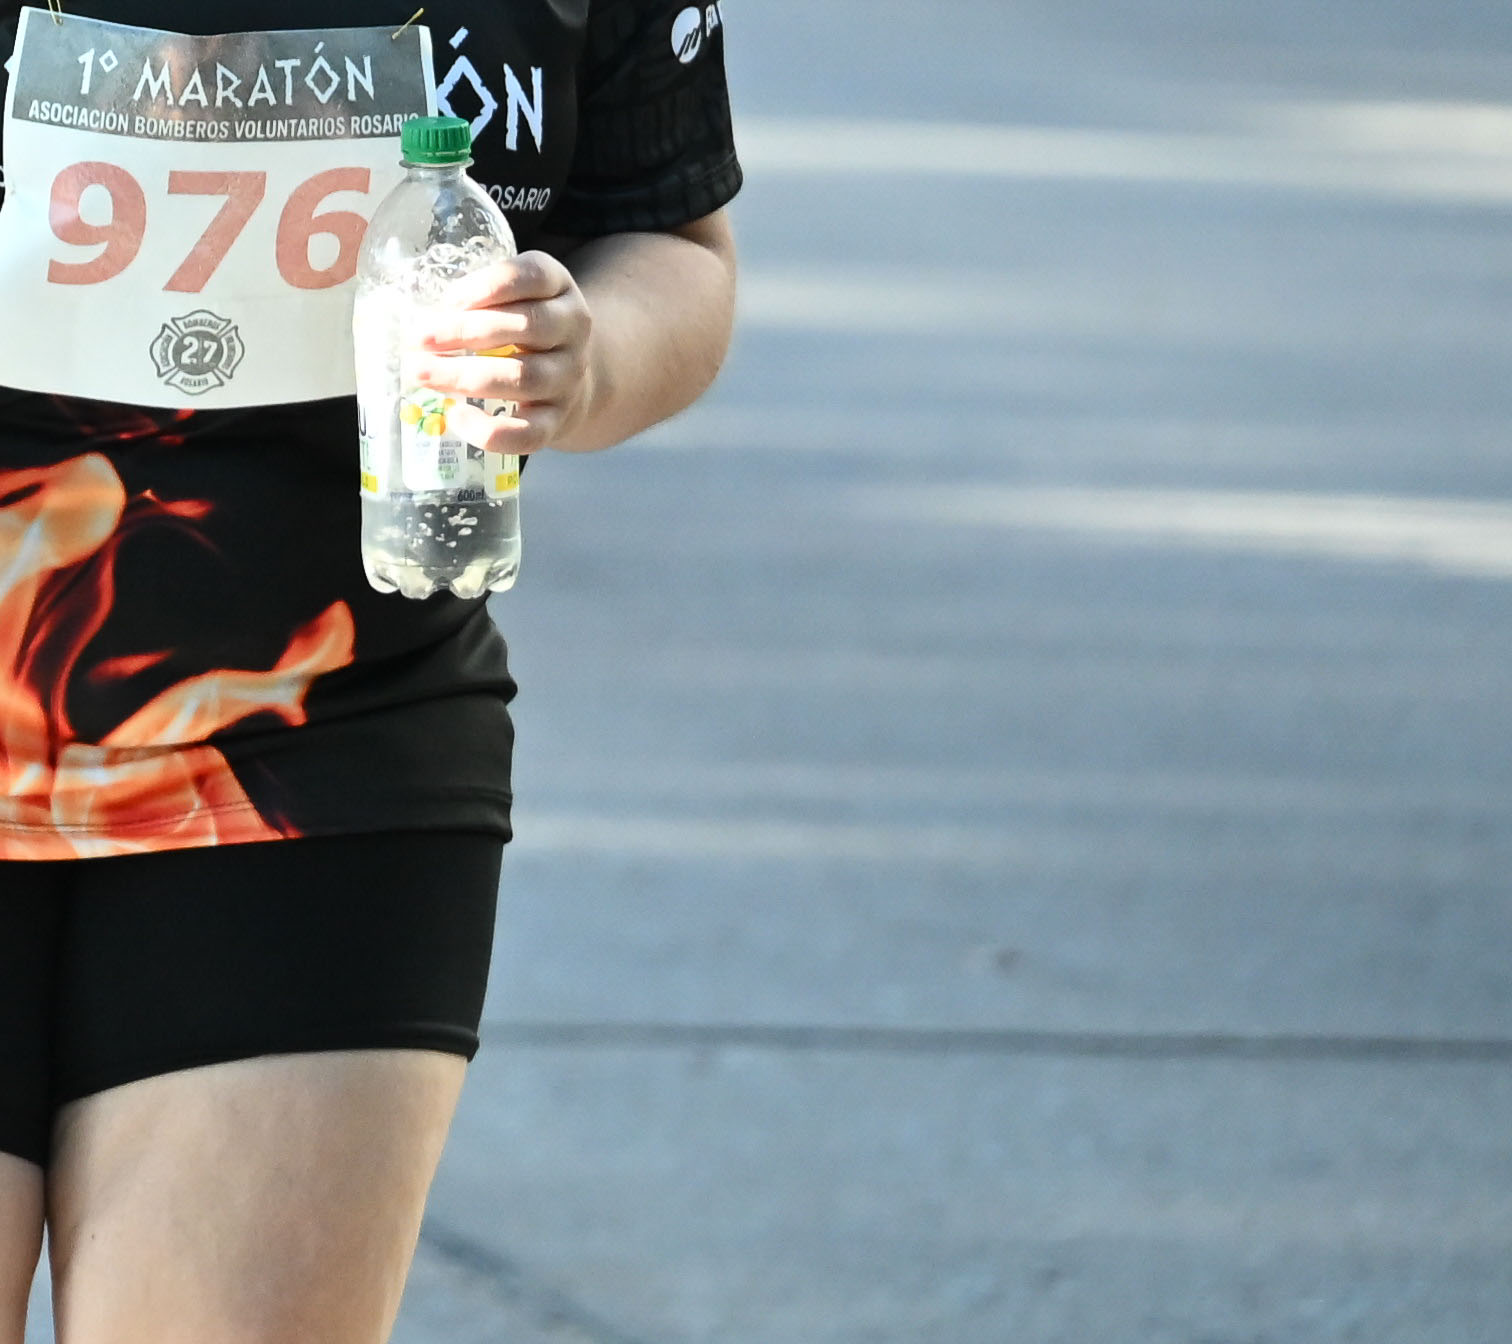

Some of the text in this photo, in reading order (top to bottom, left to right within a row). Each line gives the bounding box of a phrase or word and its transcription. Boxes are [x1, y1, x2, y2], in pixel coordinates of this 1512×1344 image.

[77, 41, 375, 110] 1° MARATÓN
[28, 99, 129, 134] ASOCIACIÓN
[135, 116, 228, 140] BOMBEROS
[233, 116, 345, 139] VOLUNTARIOS
[46, 161, 371, 293] 976
[181, 335, 218, 365] 27
